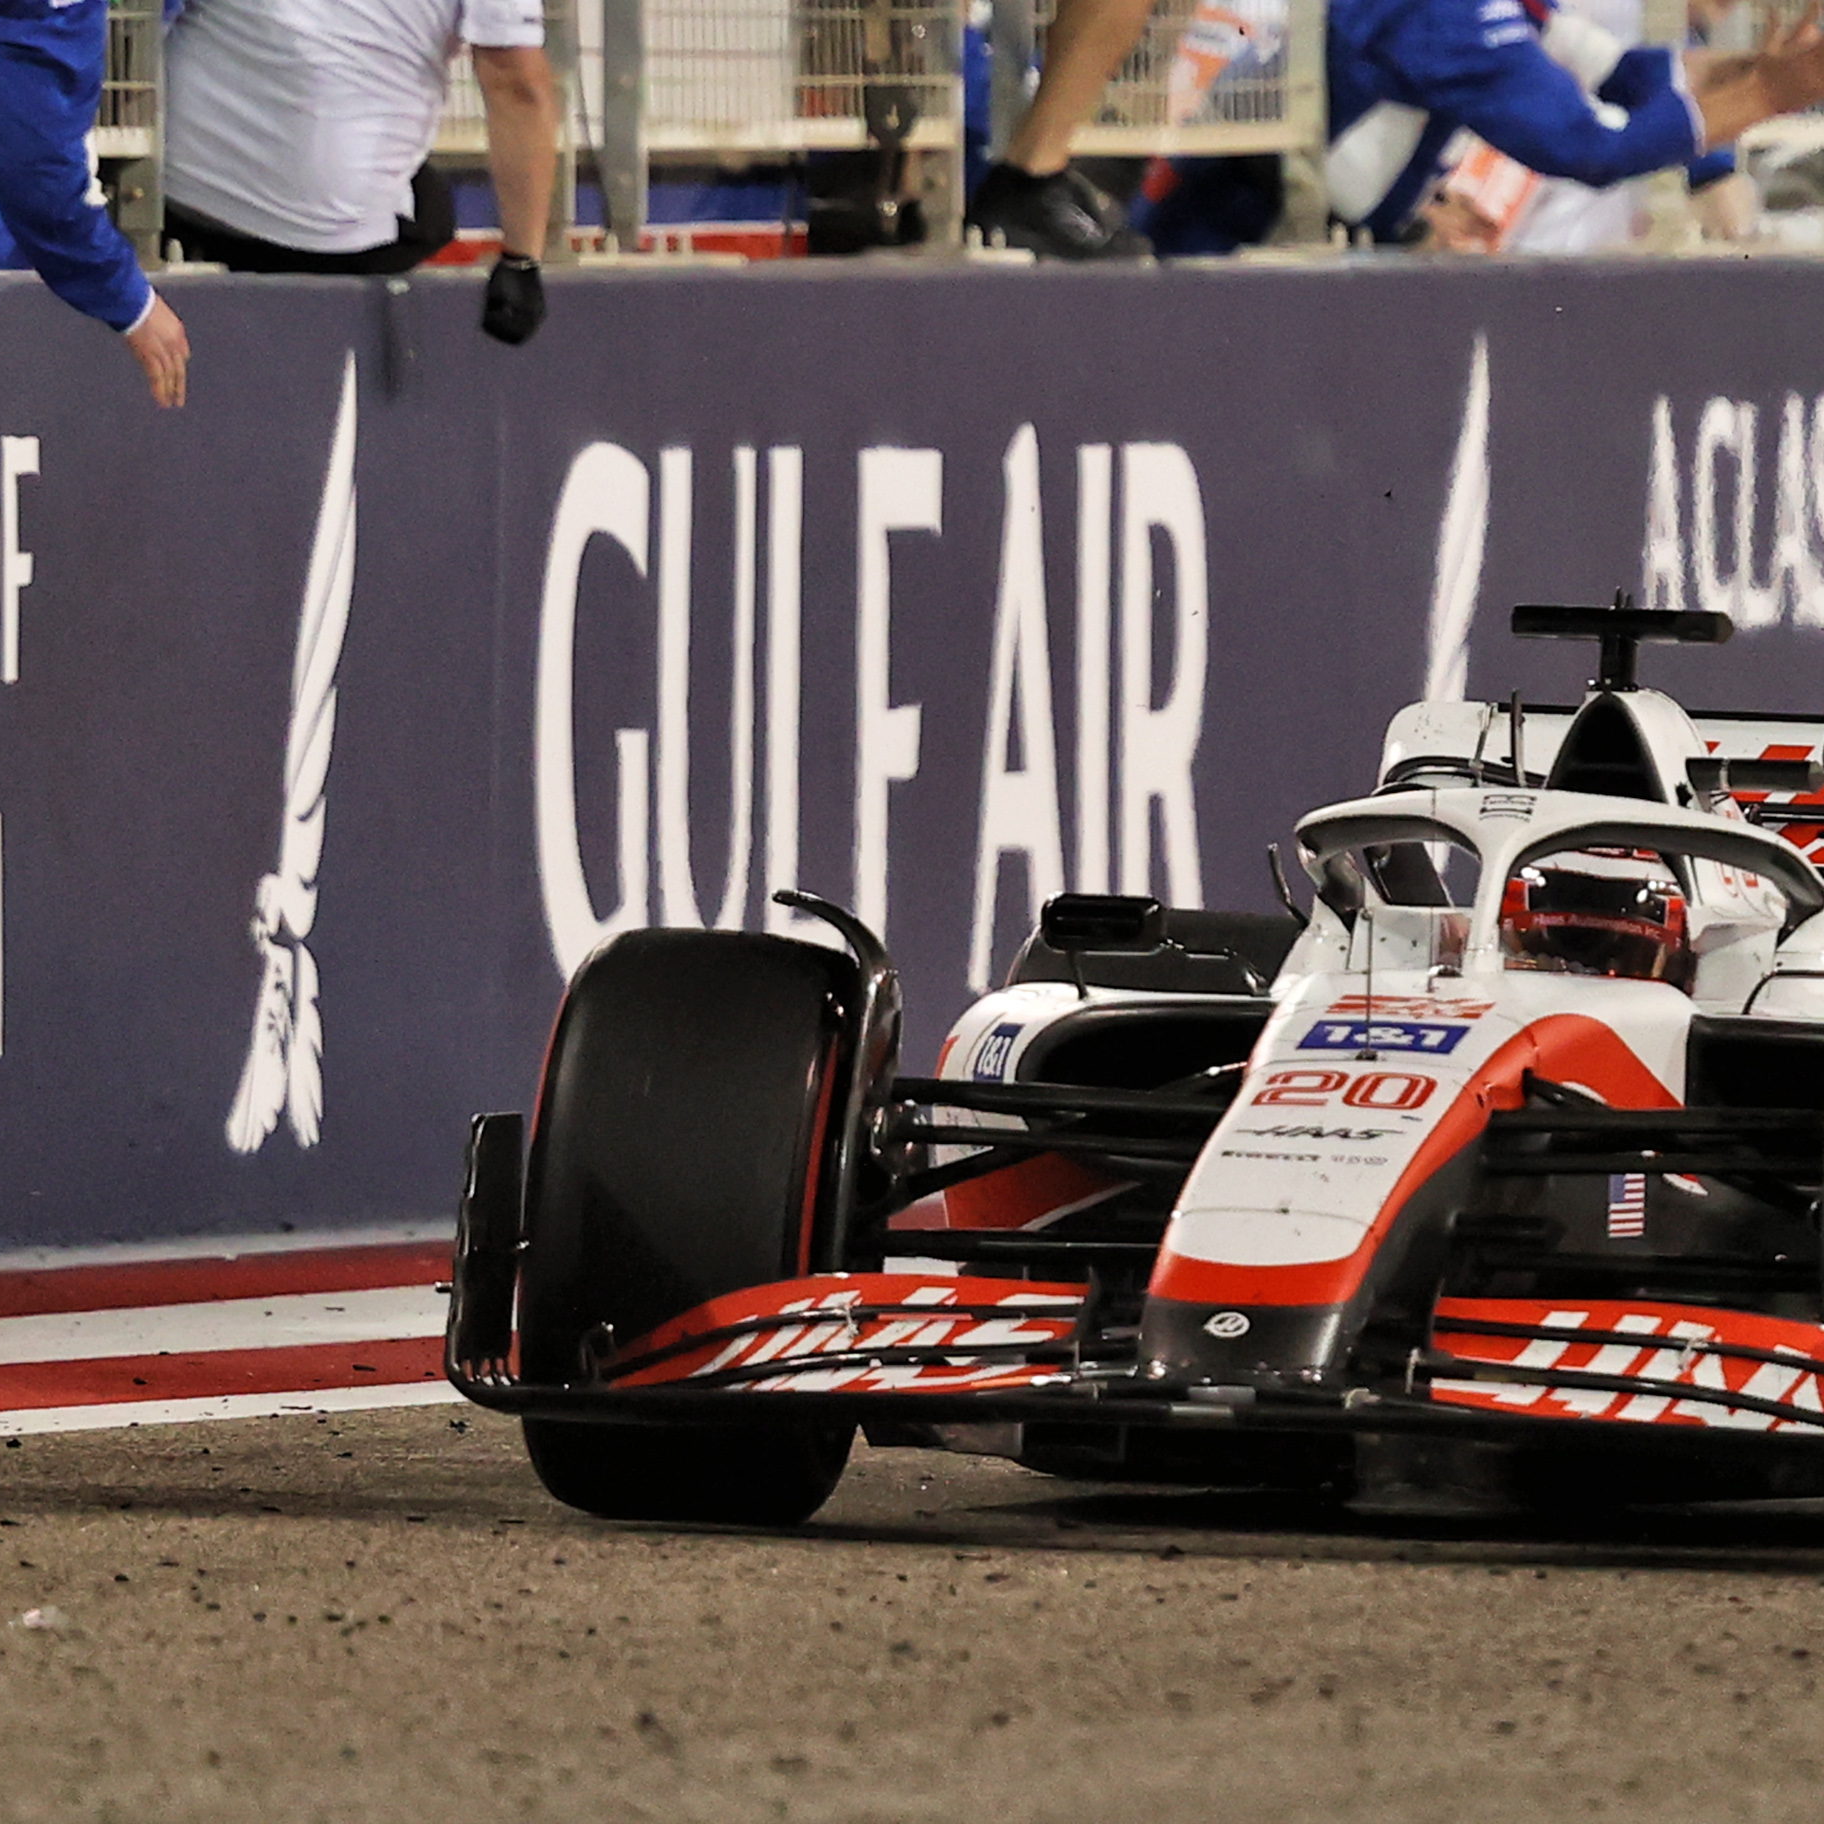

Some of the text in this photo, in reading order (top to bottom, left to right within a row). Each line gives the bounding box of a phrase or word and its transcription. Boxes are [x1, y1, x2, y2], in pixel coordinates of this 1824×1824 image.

[1641, 394, 1686, 610] A
[533, 422, 1209, 994] GULF AIR
[976, 1034, 1013, 1077] 1&1
[1325, 1025, 1447, 1049] 1&1
[1249, 1068, 1439, 1111] 20
[1234, 1124, 1406, 1141] HAAS
